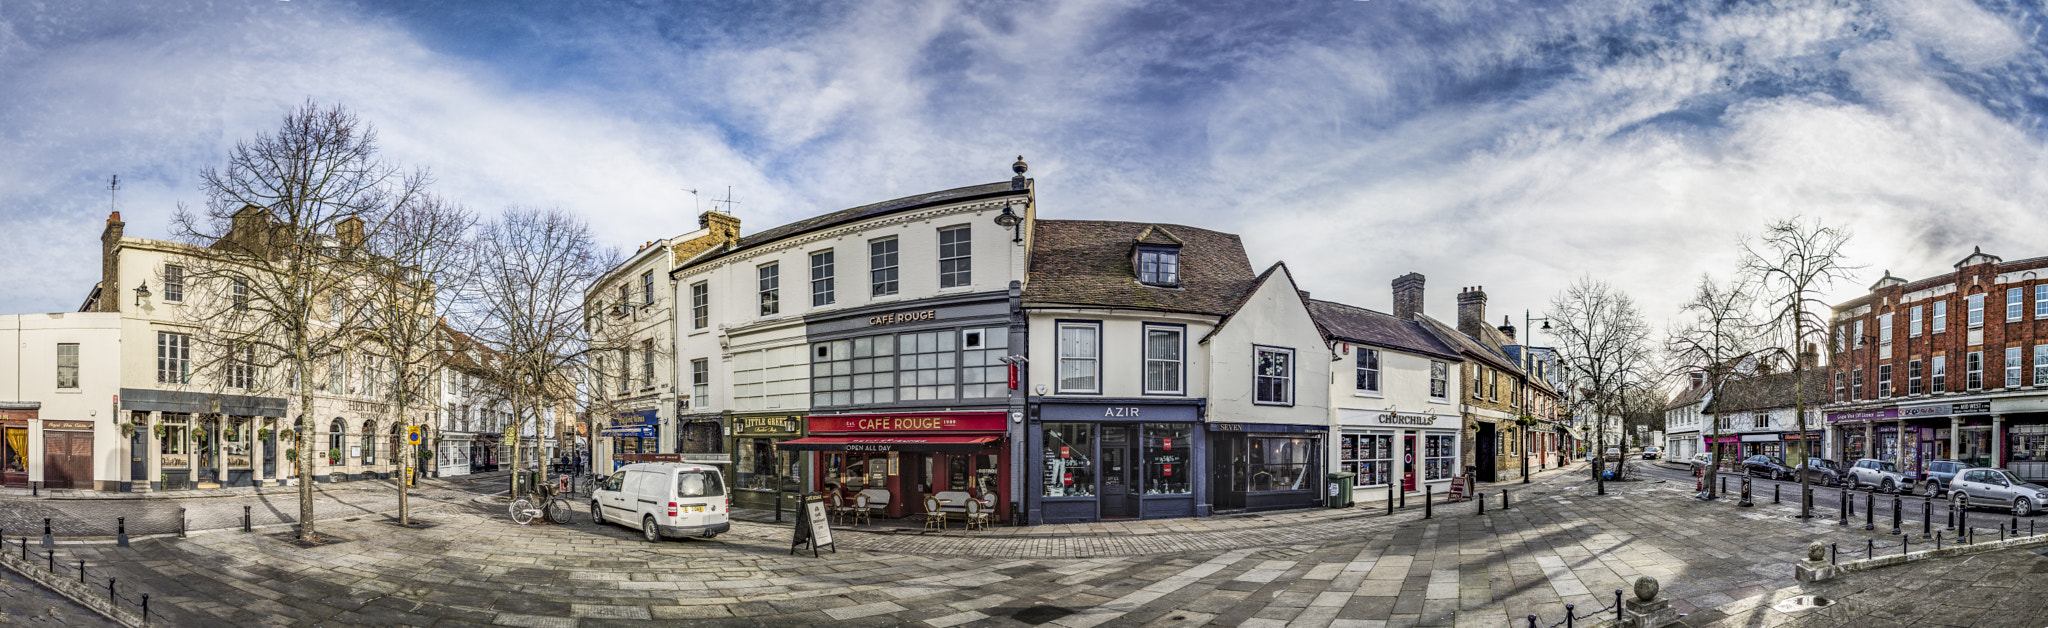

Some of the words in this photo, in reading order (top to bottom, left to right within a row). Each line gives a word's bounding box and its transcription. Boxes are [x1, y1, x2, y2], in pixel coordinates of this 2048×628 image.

[869, 312, 895, 325] CAFÉ
[897, 310, 935, 322] ROUGE
[1105, 407, 1140, 417] AZIR
[745, 417, 766, 428] LITTLE
[858, 417, 890, 429] CAFÉ
[894, 418, 941, 429] ROUGE
[1378, 413, 1434, 425] CHURCHILLS
[1220, 423, 1242, 431] SEVEN
